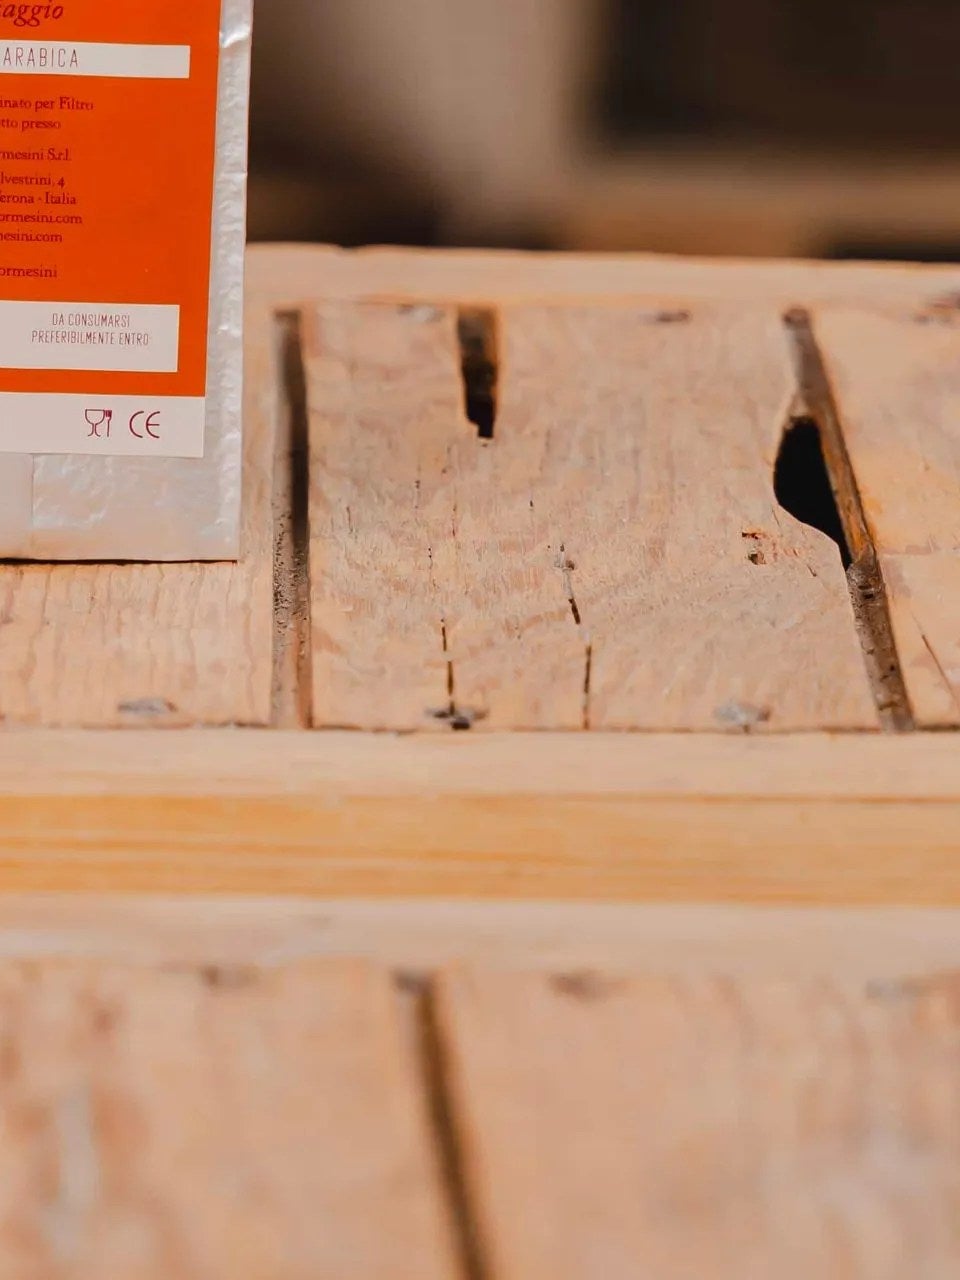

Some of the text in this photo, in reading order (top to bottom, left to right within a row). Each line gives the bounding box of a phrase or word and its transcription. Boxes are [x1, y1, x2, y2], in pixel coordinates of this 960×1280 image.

[3, 47, 79, 68] ARABICA
[35, 98, 54, 112] per
[59, 96, 93, 110] Filtro
[21, 119, 61, 132] presso
[57, 177, 65, 189] 4
[45, 191, 76, 205] Italia
[52, 313, 130, 328] DA CONSUMARSI
[32, 330, 149, 346] PREFERIBILMENTE ENTRO
[129, 410, 160, 438] CE
